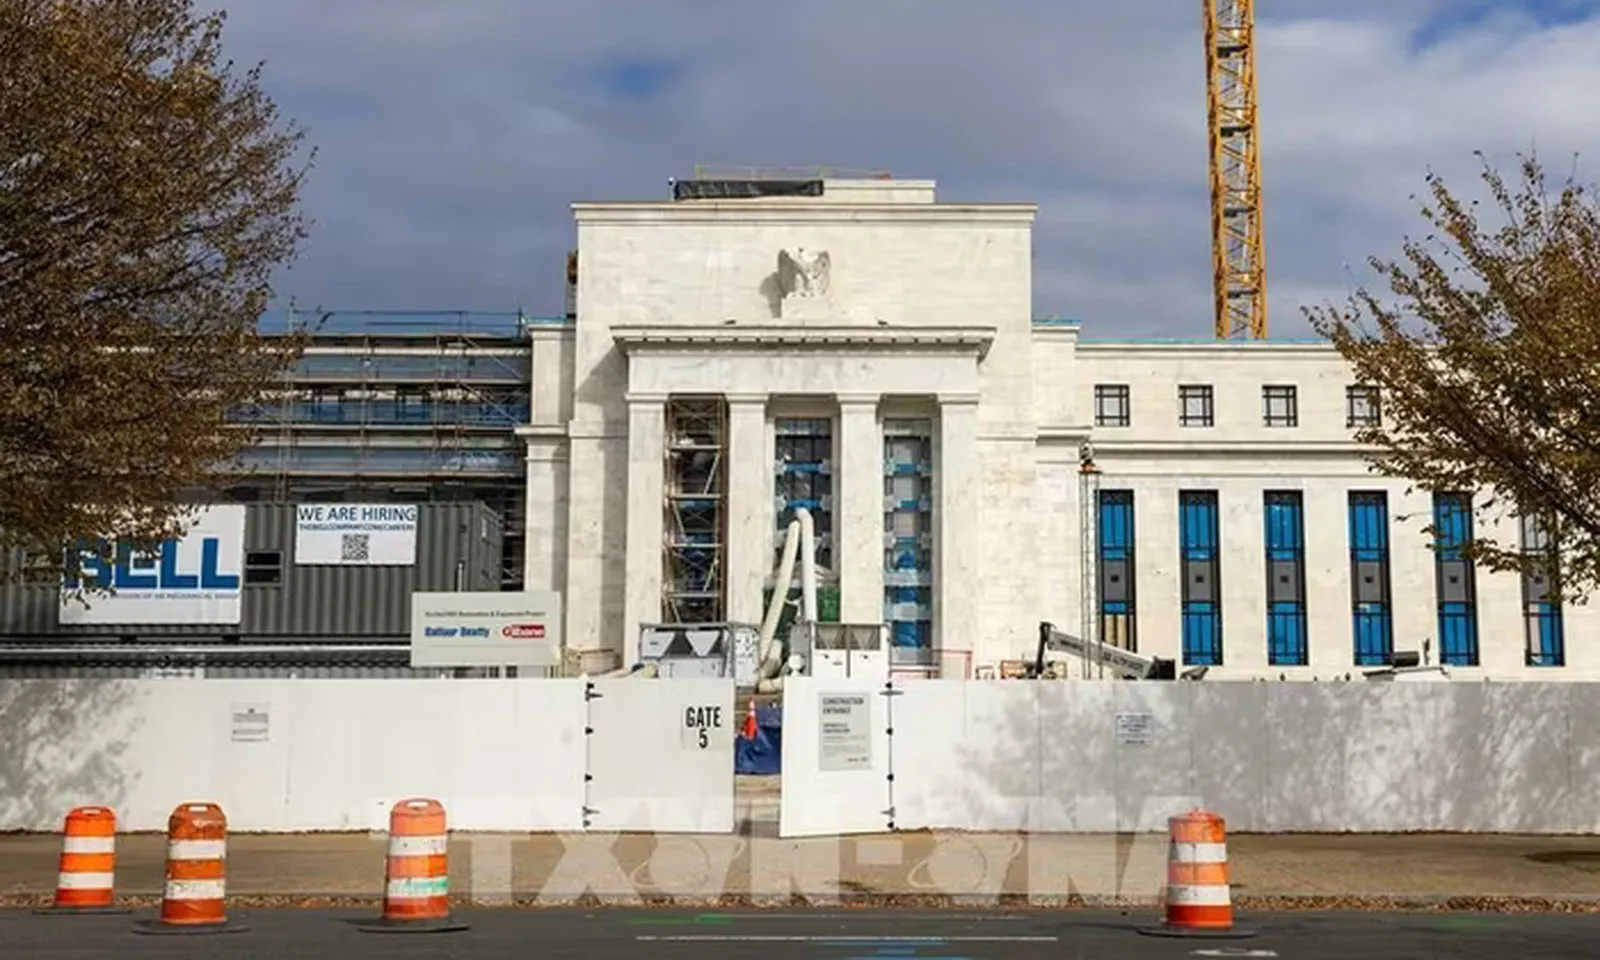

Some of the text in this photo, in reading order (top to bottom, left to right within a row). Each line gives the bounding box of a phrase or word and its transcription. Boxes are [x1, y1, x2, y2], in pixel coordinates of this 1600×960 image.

[299, 507, 417, 521] WE ARE HIRING
[425, 626, 489, 638] Balfour Beatty
[685, 706, 722, 728] GATE
[699, 728, 708, 749] 5
